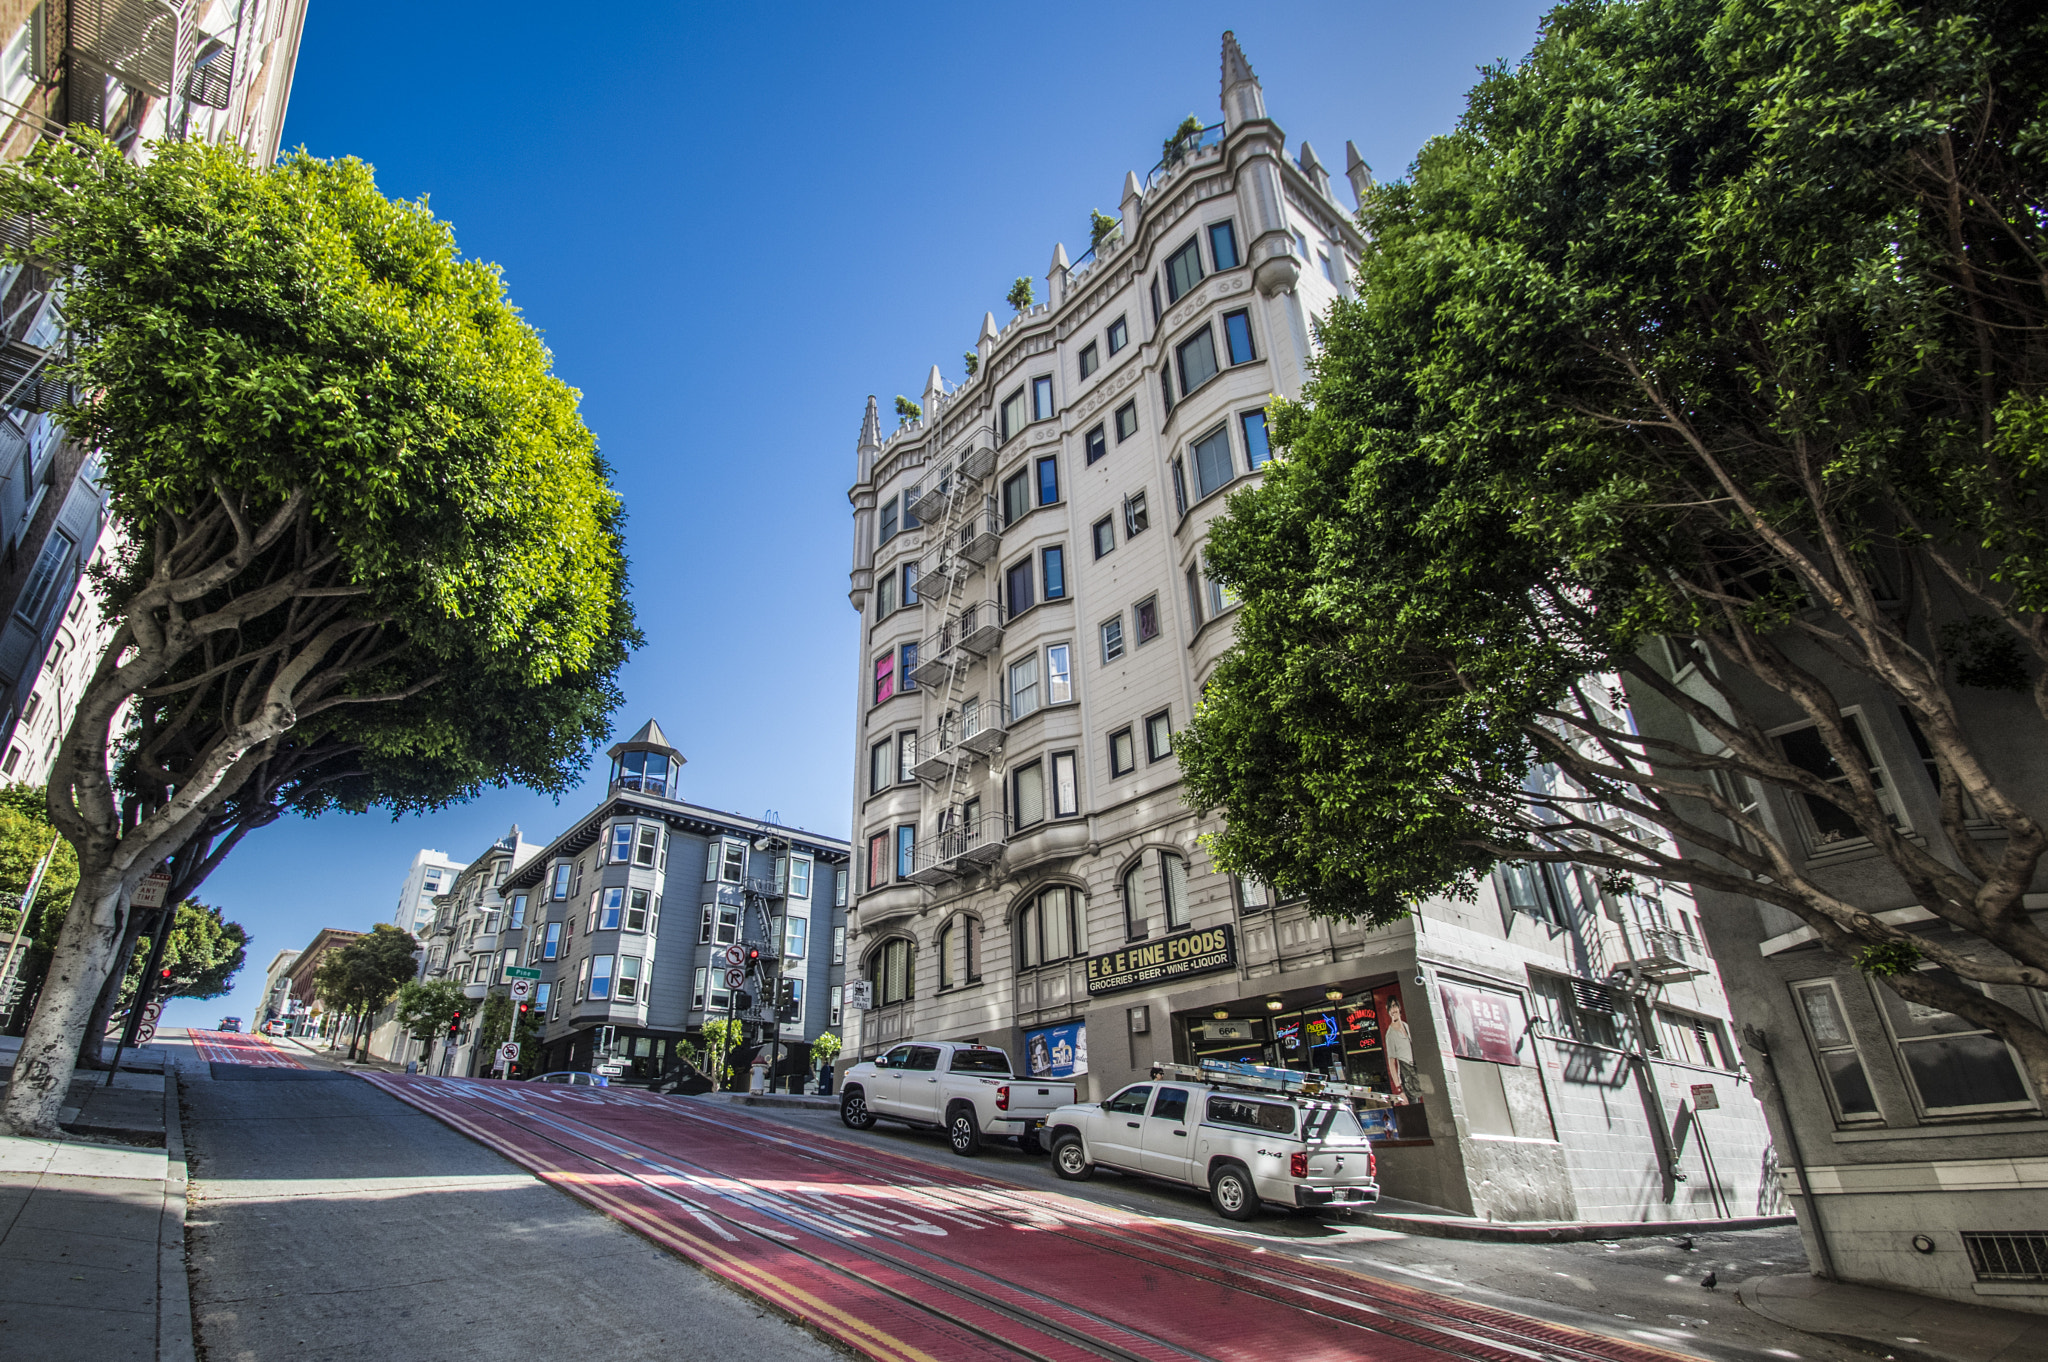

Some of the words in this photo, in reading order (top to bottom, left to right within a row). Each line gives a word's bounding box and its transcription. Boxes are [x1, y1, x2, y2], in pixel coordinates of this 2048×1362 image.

[137, 893, 157, 901] TIME
[1088, 960, 1098, 978] E
[1101, 957, 1113, 975] &
[1116, 953, 1126, 972] E
[1129, 943, 1166, 969] FINE
[1168, 929, 1226, 960] FOODS
[516, 969, 531, 977] Pine
[1089, 974, 1133, 991] GROCERIES
[1139, 968, 1162, 981] BEER
[1167, 962, 1190, 975] WINE
[1194, 953, 1228, 970] LIQUOR
[1360, 1038, 1375, 1047] OPEN
[1257, 1148, 1283, 1159] 4x4
